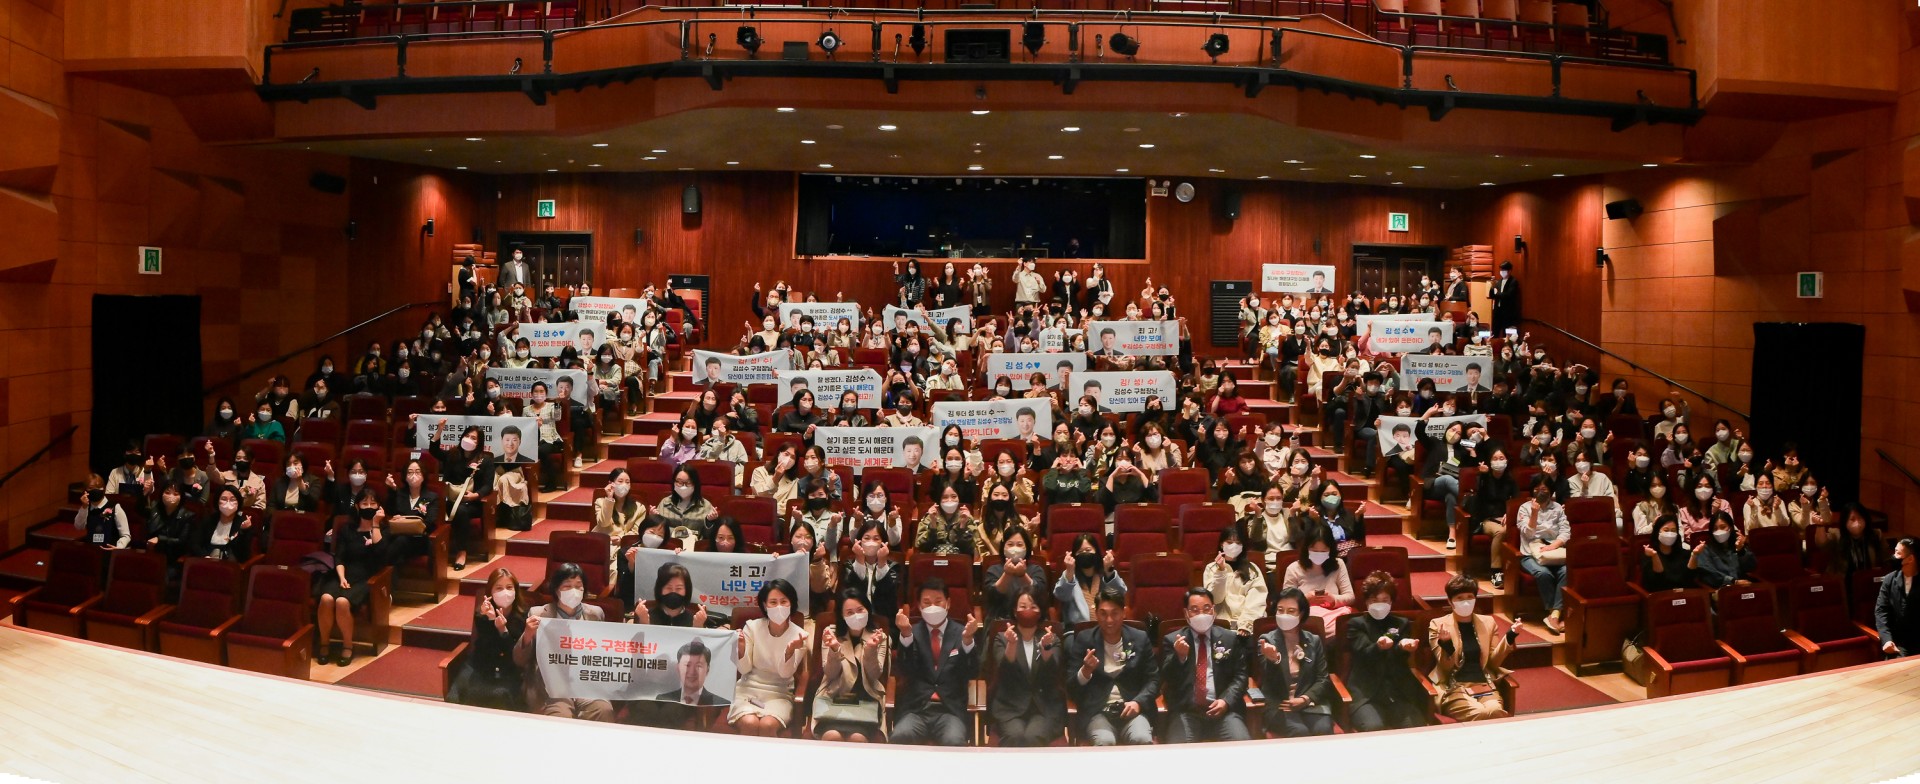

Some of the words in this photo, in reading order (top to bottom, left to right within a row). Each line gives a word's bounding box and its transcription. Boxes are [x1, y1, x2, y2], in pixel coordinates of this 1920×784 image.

[828, 458, 862, 466] 해운대는
[864, 458, 892, 466] 세계로!
[730, 566, 742, 578] 최
[748, 566, 766, 578] 고!
[721, 580, 747, 592] 너만
[709, 595, 739, 606] 김성수
[559, 636, 598, 651] 김성수
[601, 639, 658, 655] 구청장님!
[548, 654, 578, 665] 빛나는
[582, 654, 634, 669] 해운대구의
[637, 658, 668, 670] 미래를
[579, 670, 634, 683] 응원합니다.
